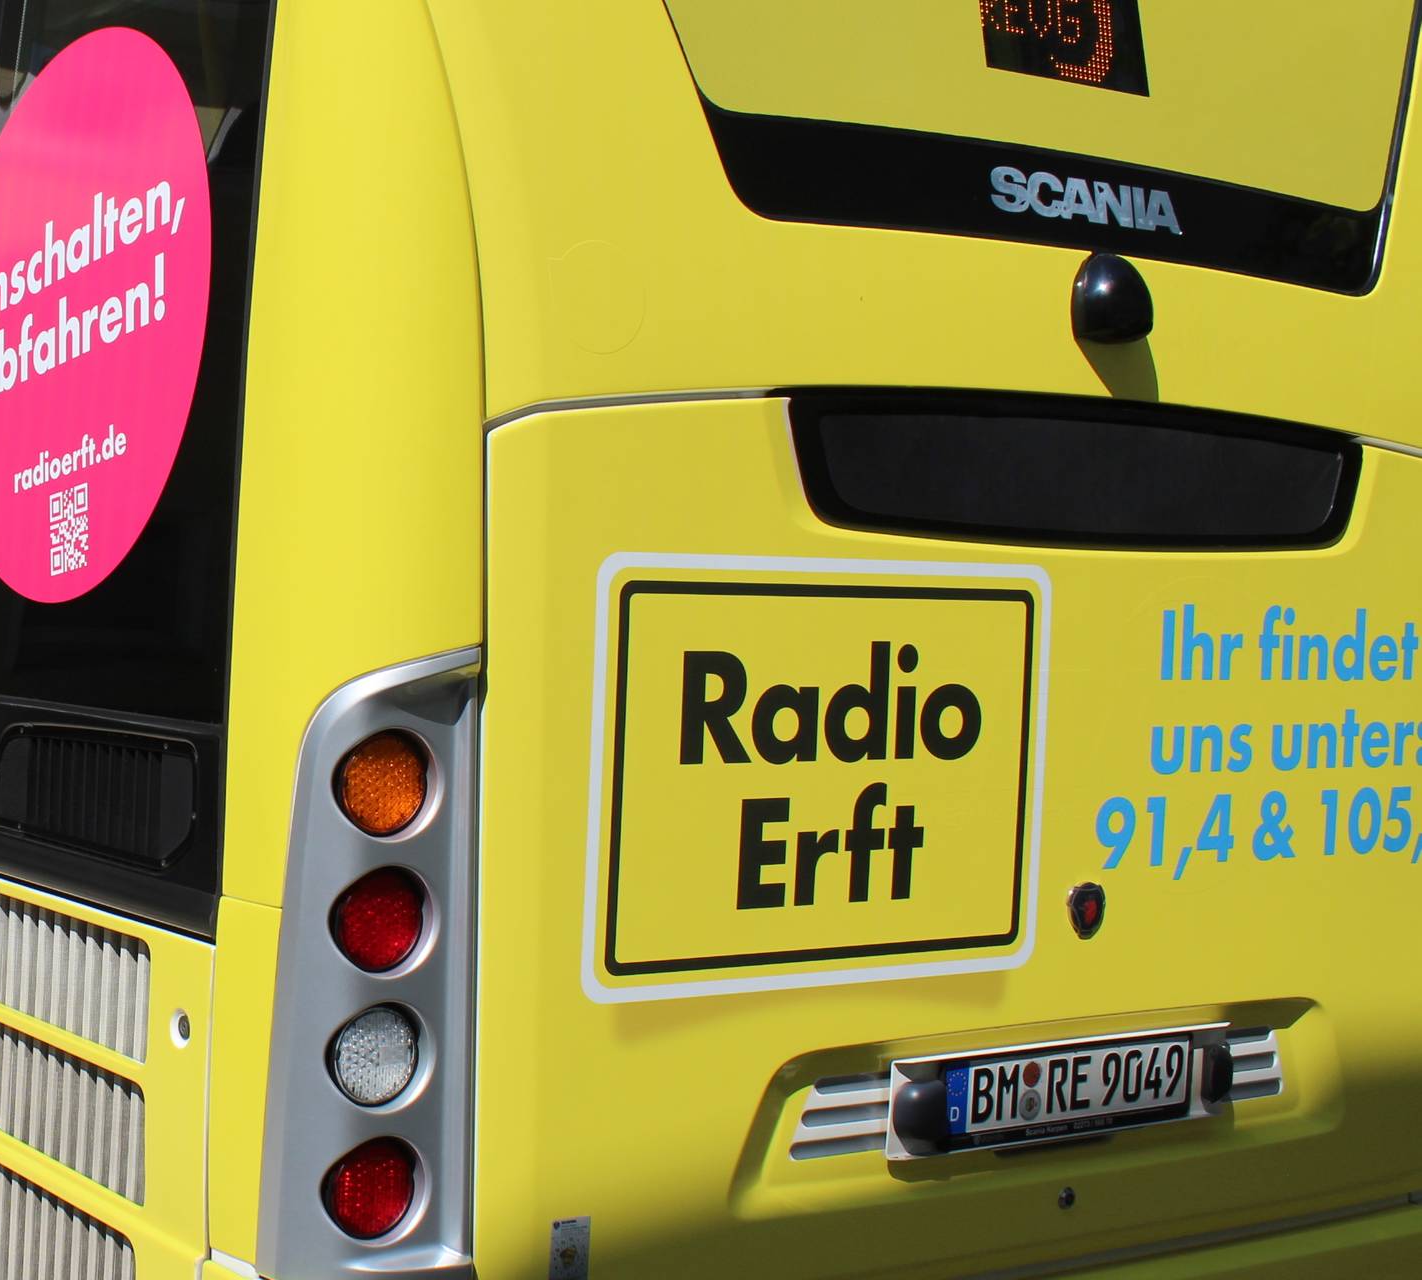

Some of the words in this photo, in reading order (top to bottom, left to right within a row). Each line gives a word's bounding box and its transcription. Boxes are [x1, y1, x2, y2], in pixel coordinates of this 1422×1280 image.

[990, 166, 1183, 235] SCANIA
[13, 424, 127, 494] radioerft.de
[1160, 603, 1243, 680] Ihr
[1259, 605, 1419, 682] findet
[679, 641, 982, 765] Radio
[1150, 723, 1253, 775] uns
[1271, 709, 1422, 771] unter
[736, 782, 924, 909] Erft
[1095, 793, 1235, 880] 91,4
[1252, 790, 1297, 861] &
[949, 1106, 960, 1122] D
[971, 1063, 1020, 1124] BM
[1045, 1054, 1091, 1115] RE
[1101, 1044, 1184, 1107] 9049
